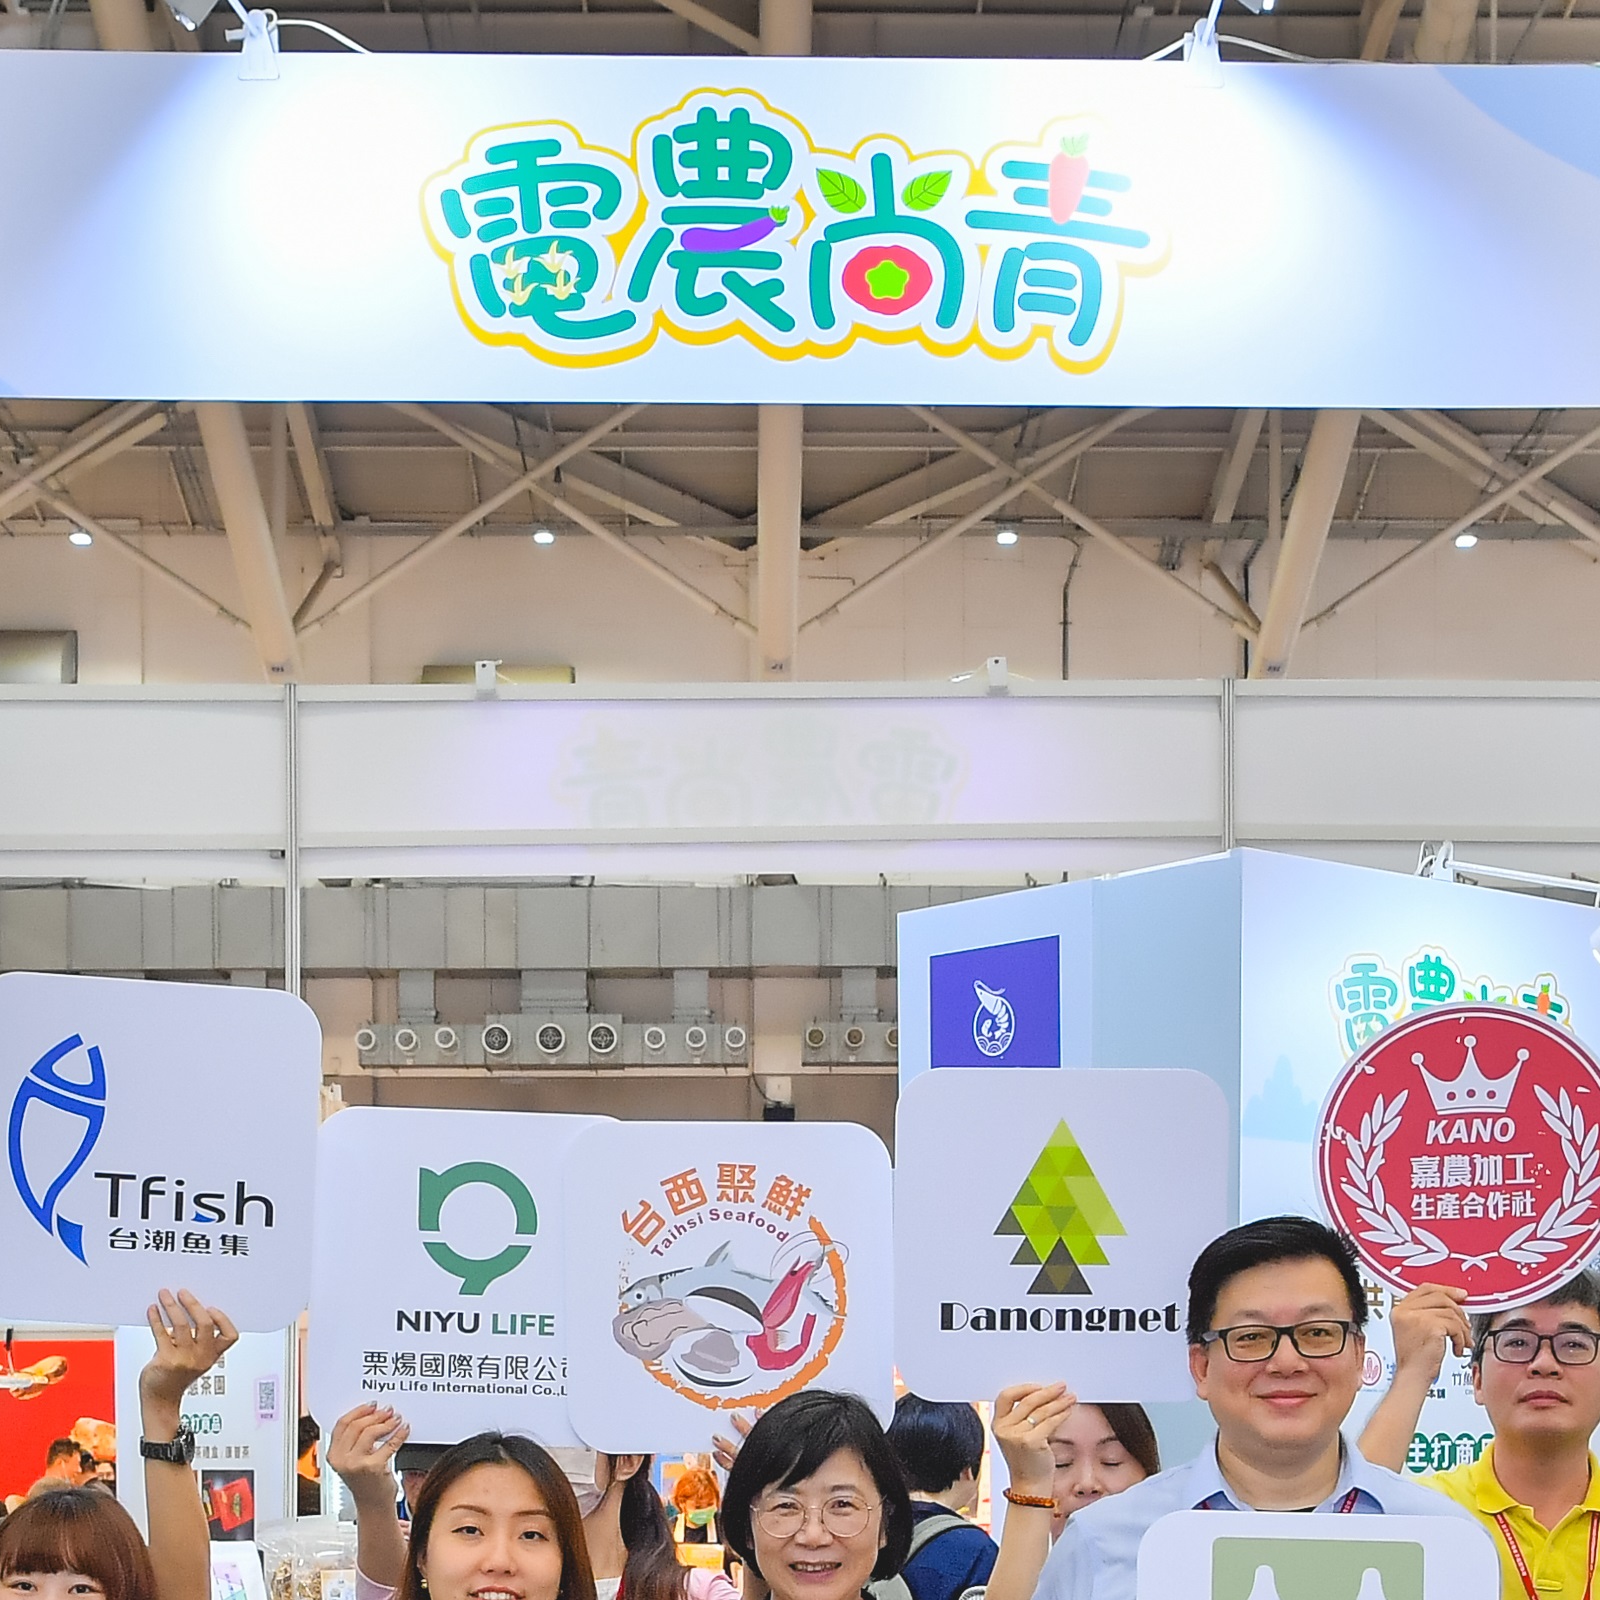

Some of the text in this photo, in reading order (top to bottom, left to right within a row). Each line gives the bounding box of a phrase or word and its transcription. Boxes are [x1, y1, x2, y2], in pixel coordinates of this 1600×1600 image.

[440, 106, 1152, 347] 電農尚青
[1425, 1116, 1516, 1145] KANO
[1410, 1152, 1535, 1190] 嘉農加工
[94, 1171, 275, 1228] Tfish
[621, 1162, 812, 1248] 台西聚鮮
[1410, 1190, 1536, 1221] 生產合作社
[108, 1228, 250, 1257] 台潮魚集
[650, 1208, 790, 1259] Taihsi Seafood
[396, 1309, 555, 1337] NIYU LIFE
[940, 1301, 1182, 1333] Danongnet
[361, 1379, 396, 1393] Niyu
[399, 1380, 428, 1393] Life
[432, 1381, 528, 1395] International
